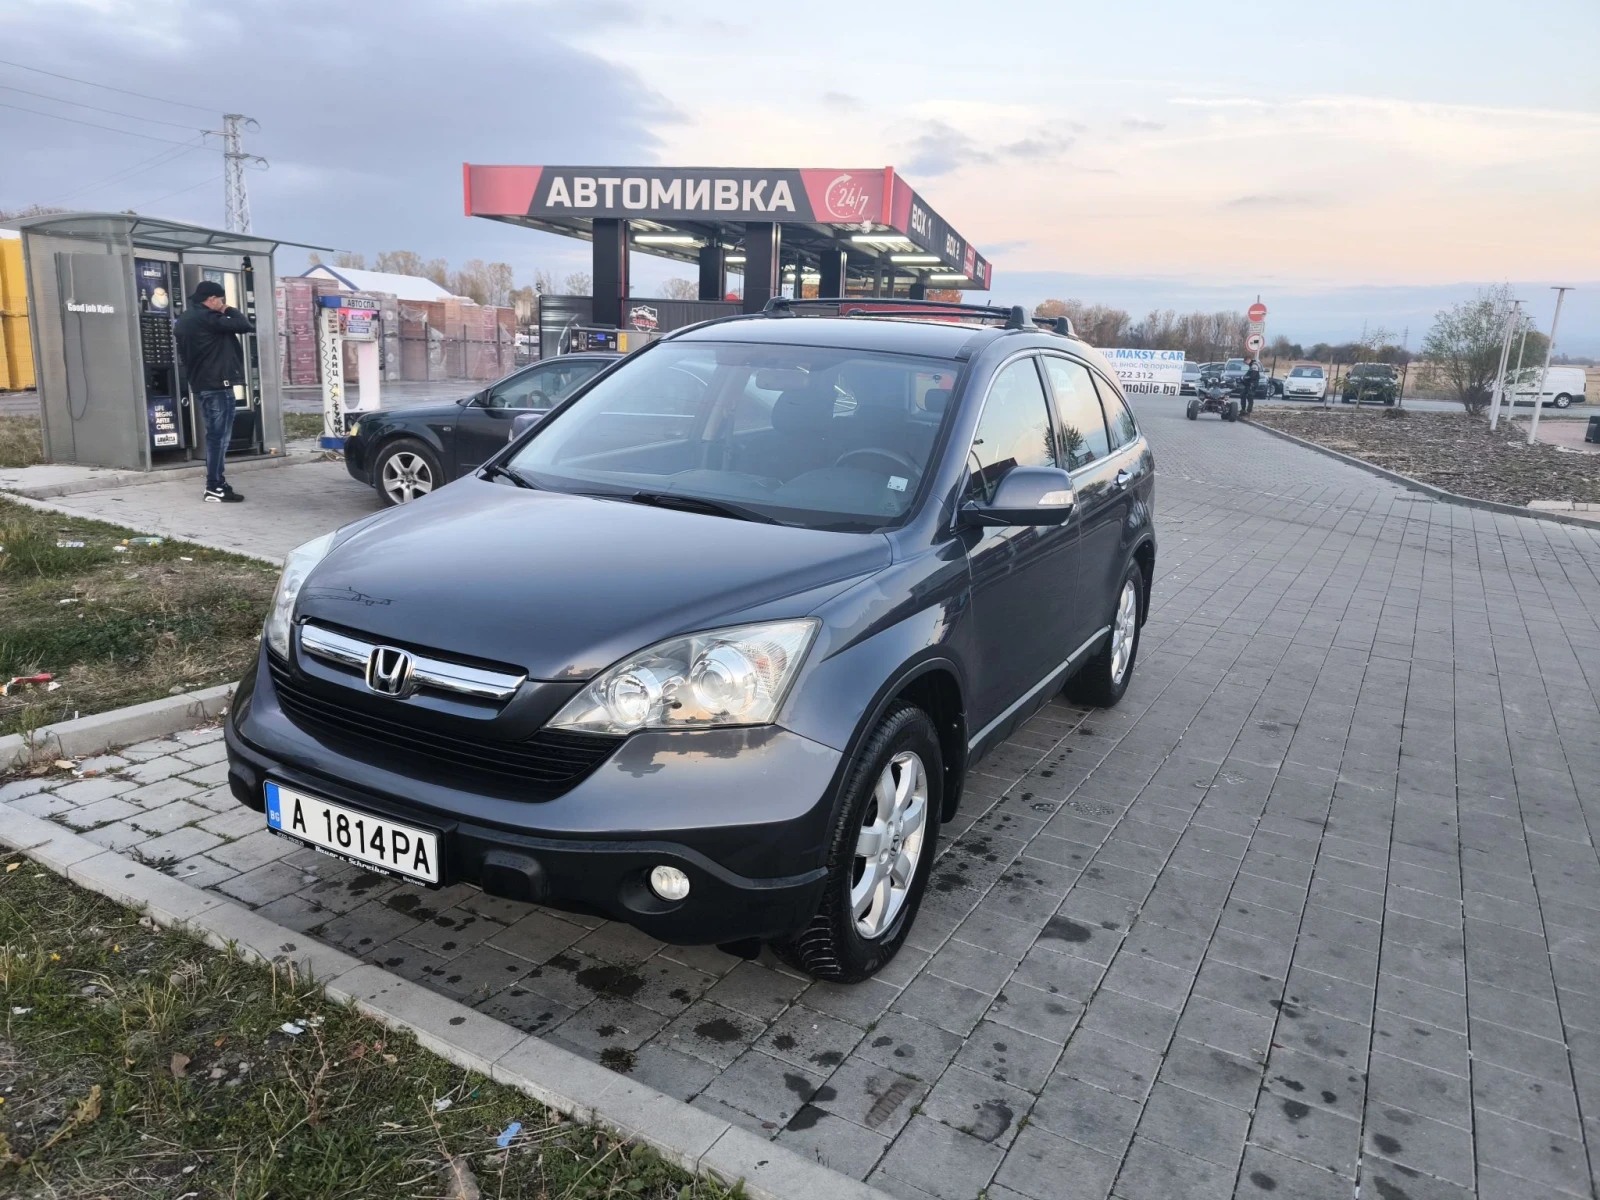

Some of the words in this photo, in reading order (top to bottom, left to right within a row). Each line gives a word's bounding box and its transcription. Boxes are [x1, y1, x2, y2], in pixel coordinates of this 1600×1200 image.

[545, 176, 796, 212] АВТОМИВКА
[837, 187, 869, 215] 24/7
[911, 203, 927, 237] BOX
[928, 218, 932, 240] 1
[946, 233, 957, 258] BOX
[67, 303, 85, 311] Good
[347, 299, 362, 307] АВТО
[363, 300, 375, 308] СПА
[331, 338, 339, 377] ГЛАНЦ
[1116, 350, 1155, 360] MAKSY
[1161, 351, 1184, 361] CAR
[1123, 383, 1177, 395] mobile.bg
[269, 809, 280, 822] BG
[292, 798, 307, 834] A
[348, 857, 390, 875] Schreiber
